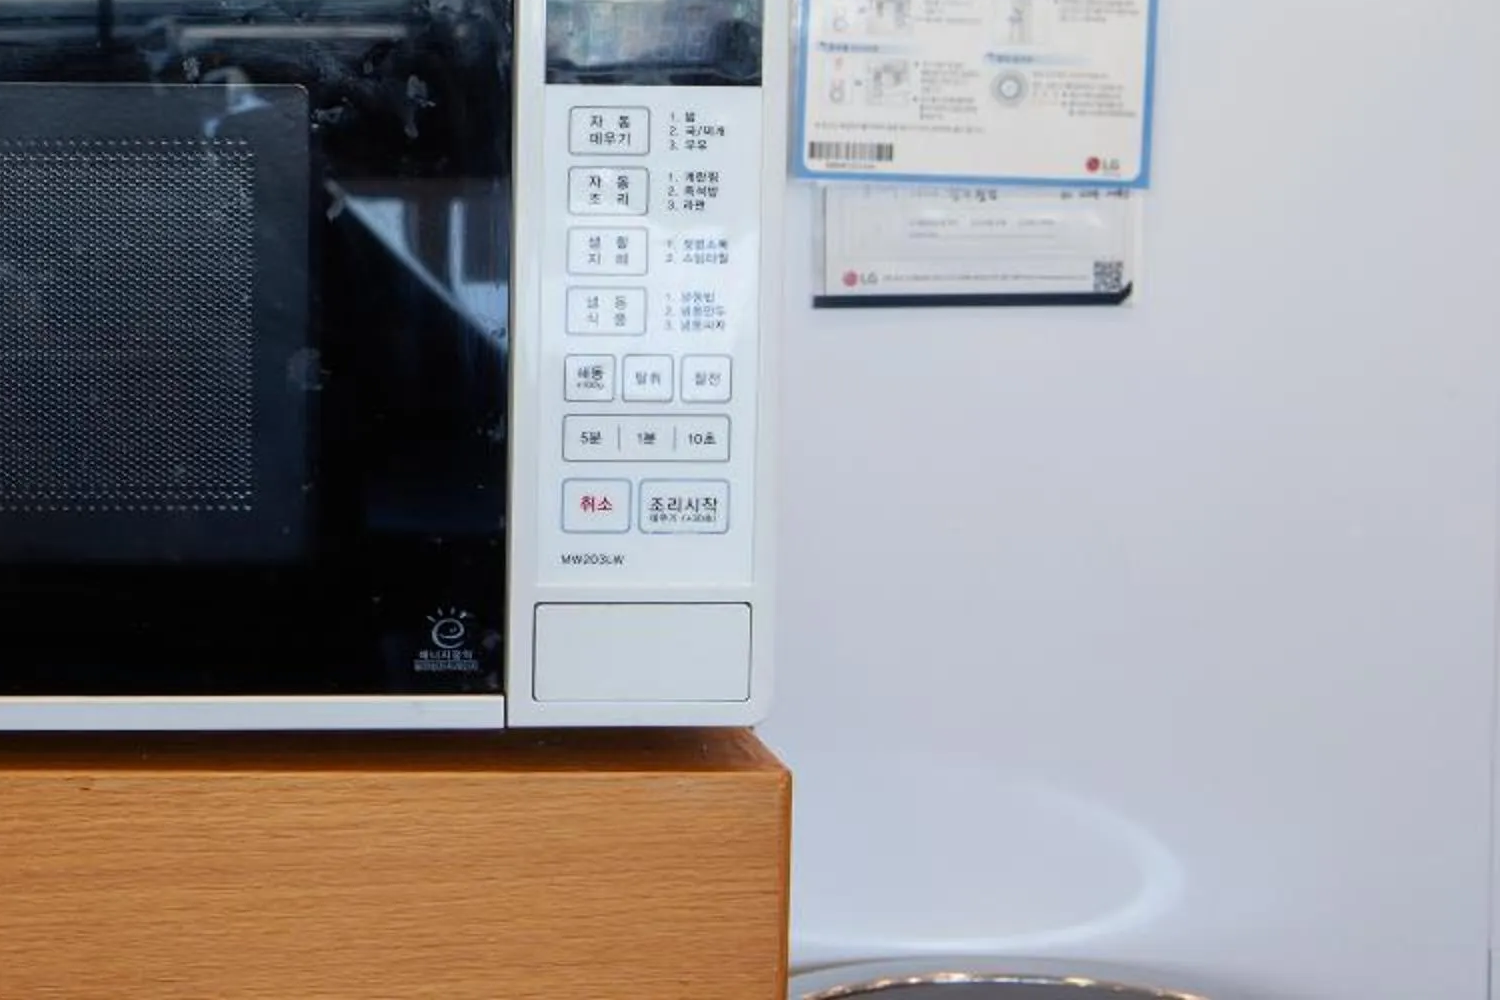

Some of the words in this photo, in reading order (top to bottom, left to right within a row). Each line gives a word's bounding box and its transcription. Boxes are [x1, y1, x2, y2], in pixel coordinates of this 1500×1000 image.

[589, 131, 631, 146] 데우기
[684, 139, 708, 151] 우유
[577, 366, 604, 381] 해동
[579, 431, 603, 446] 5분
[637, 431, 657, 446] 1분
[688, 431, 717, 446] 10초
[579, 495, 613, 514] 취소
[647, 496, 718, 514] 조리시작
[560, 554, 625, 566] MW203LW
